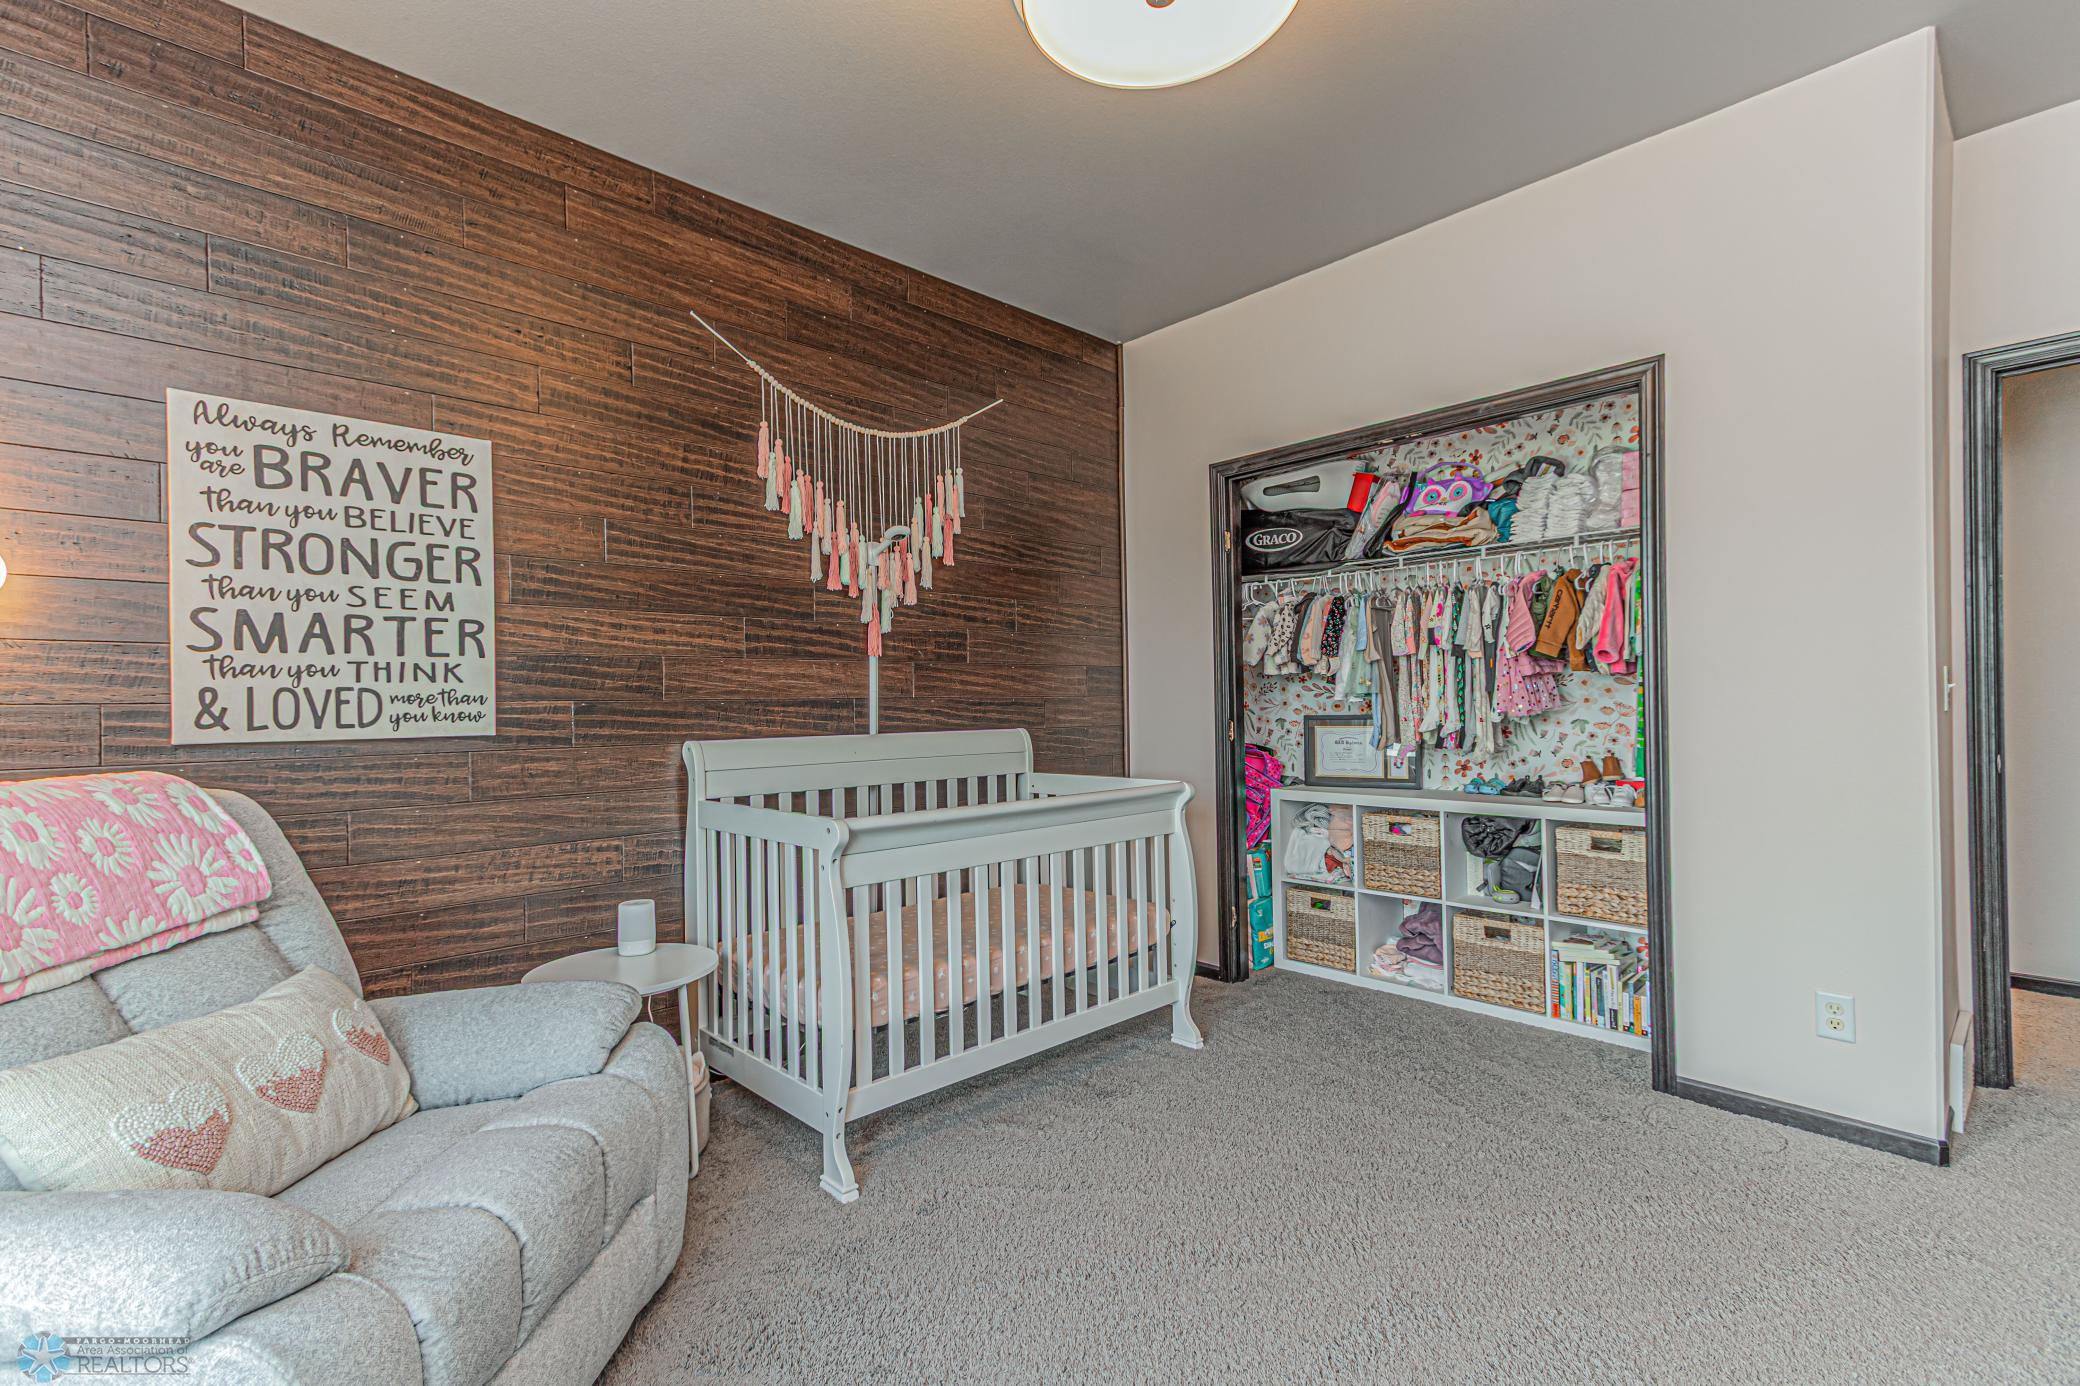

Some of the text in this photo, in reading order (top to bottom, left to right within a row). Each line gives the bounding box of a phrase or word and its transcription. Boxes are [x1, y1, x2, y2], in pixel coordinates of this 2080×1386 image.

[185, 440, 244, 463] you
[193, 399, 475, 467] Always Remember
[200, 459, 246, 478] are
[253, 444, 479, 514] BRAVER
[199, 485, 476, 541] than you BELIEVE
[184, 520, 482, 587] STRONGER
[1252, 532, 1297, 546] GRACO
[200, 573, 456, 613] than you SEEM
[185, 606, 487, 659] SMARTER
[202, 653, 464, 689] than you THINK
[193, 686, 383, 733] & LOVED
[389, 687, 488, 708] more than
[388, 706, 487, 732] you know
